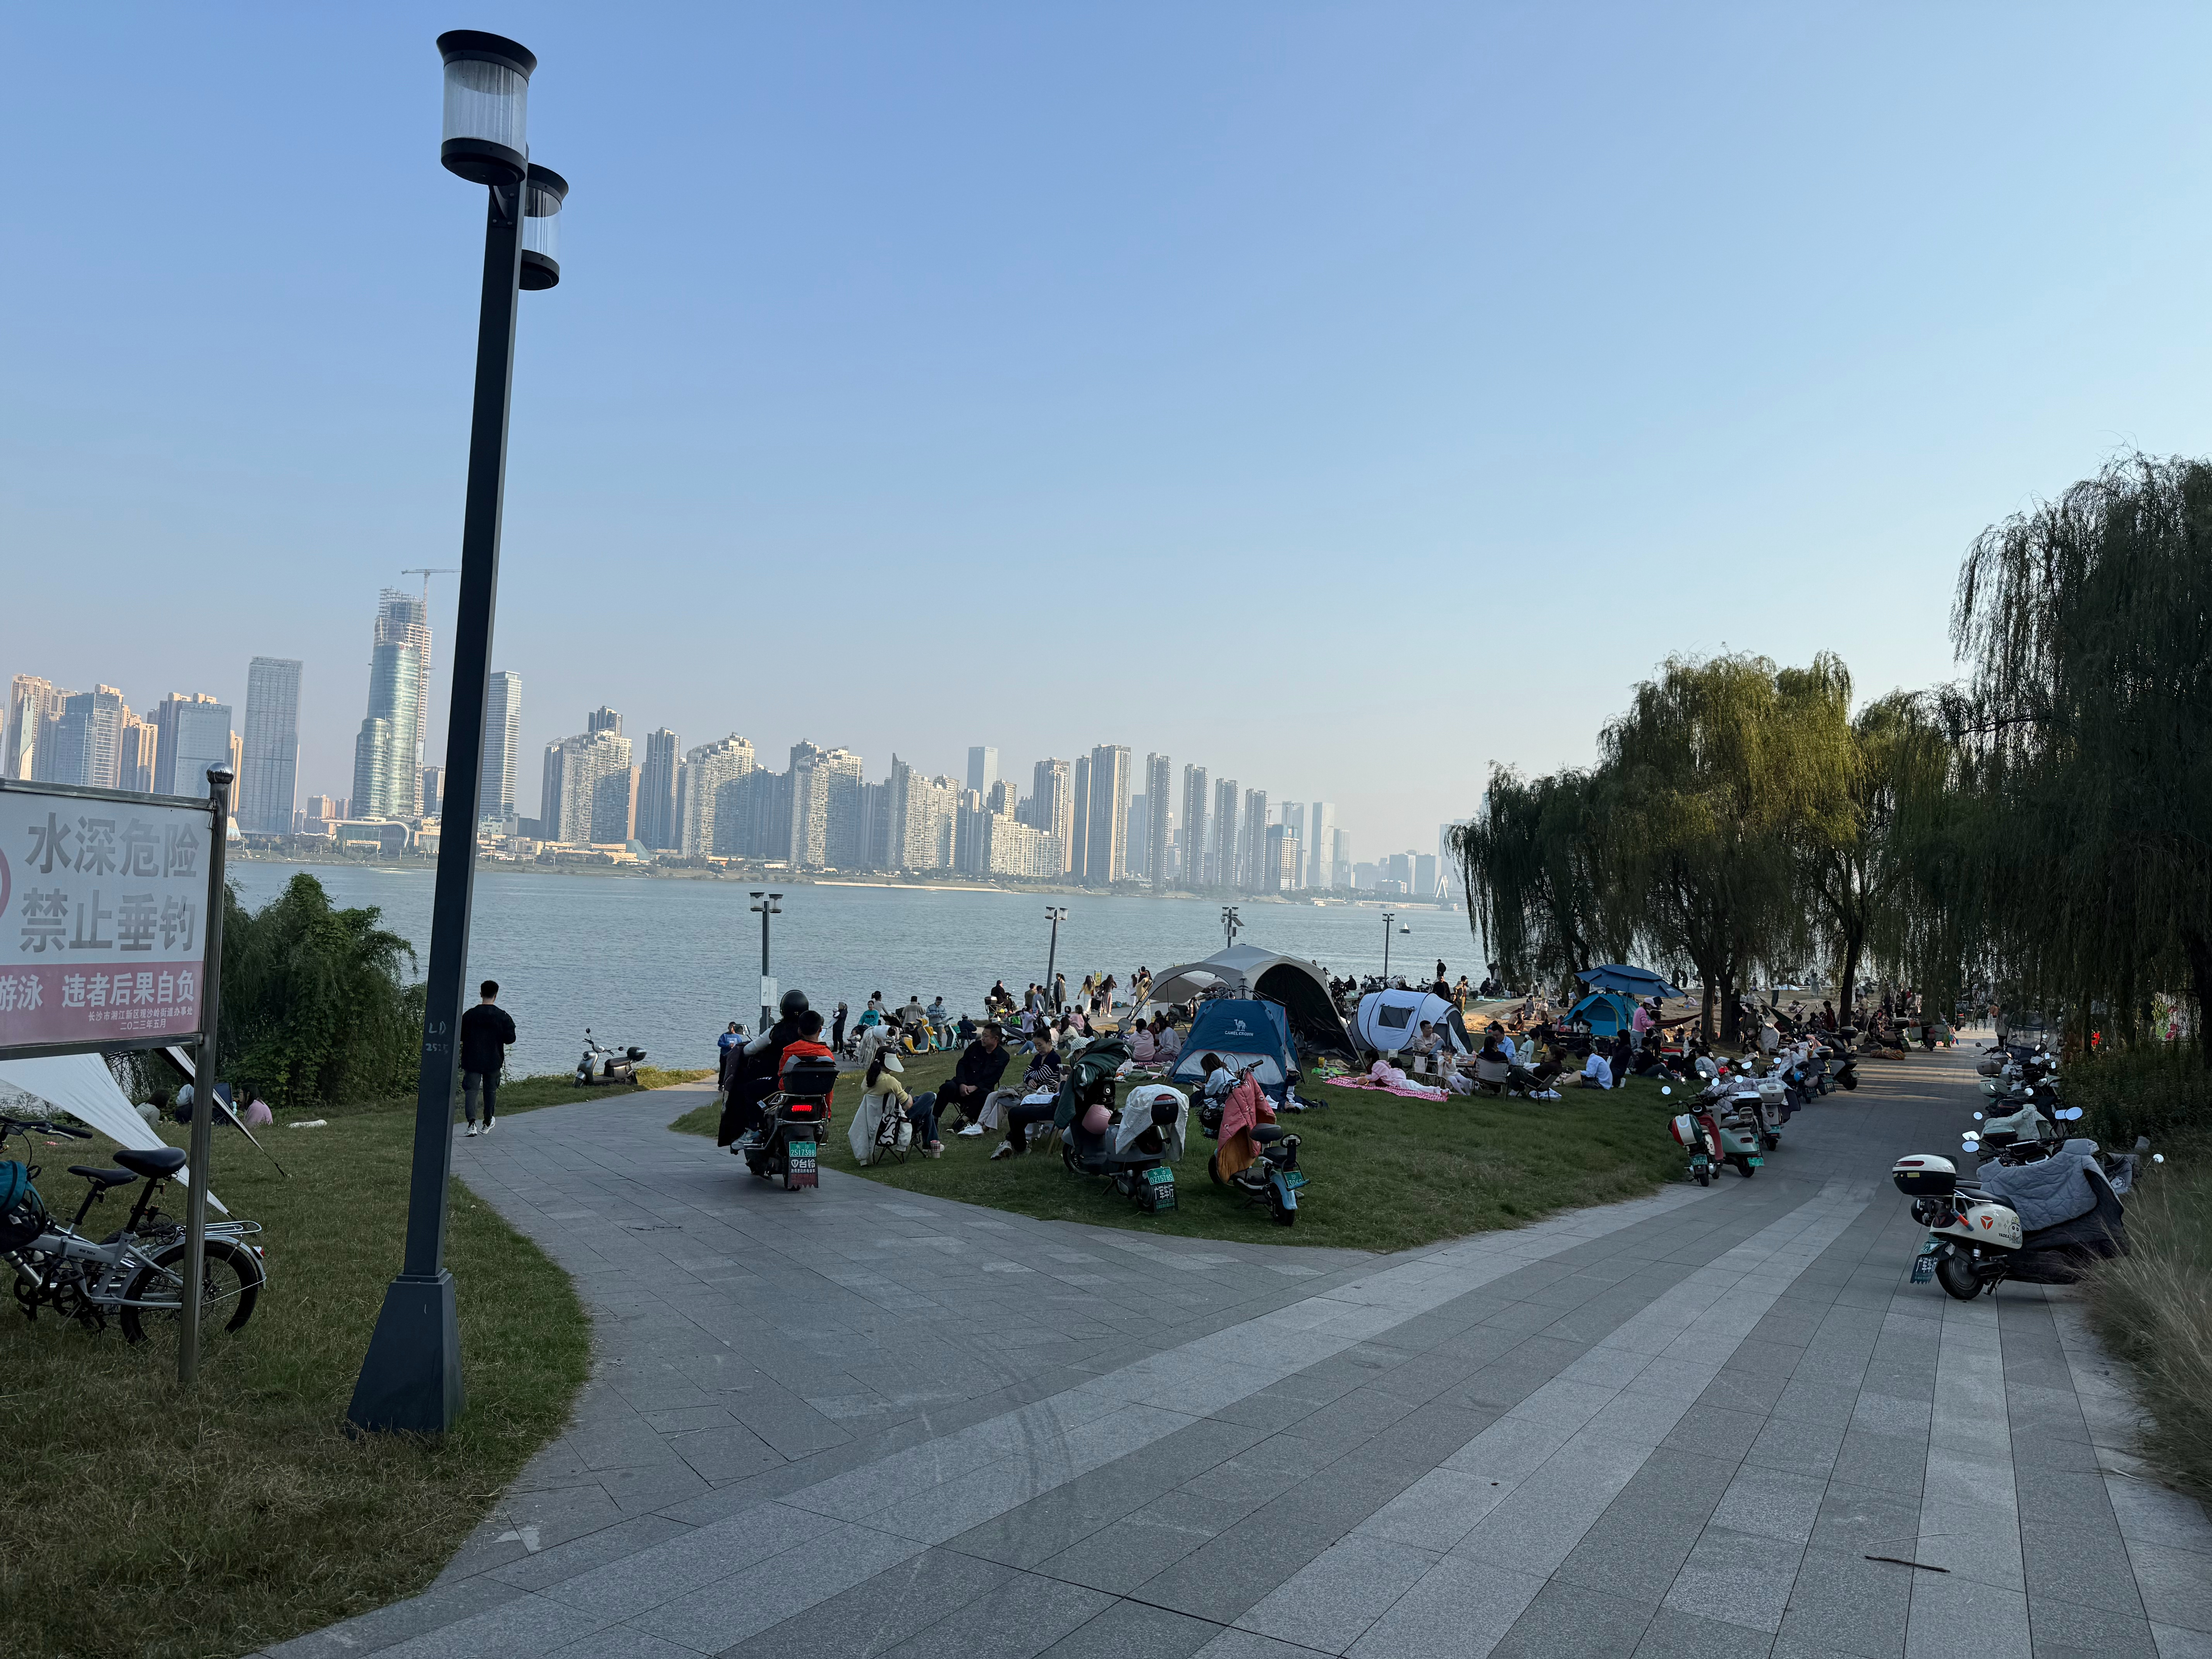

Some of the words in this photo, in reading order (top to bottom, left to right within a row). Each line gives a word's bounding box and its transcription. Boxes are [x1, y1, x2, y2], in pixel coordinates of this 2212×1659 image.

[25, 812, 199, 878] 水深危险
[19, 888, 196, 953] 禁止垂钓
[62, 970, 194, 1008] 违者后果自负
[88, 1006, 192, 1022] 长沙市湘江新区观沙岭街道办事处
[1150, 1174, 1173, 1183] 0275785
